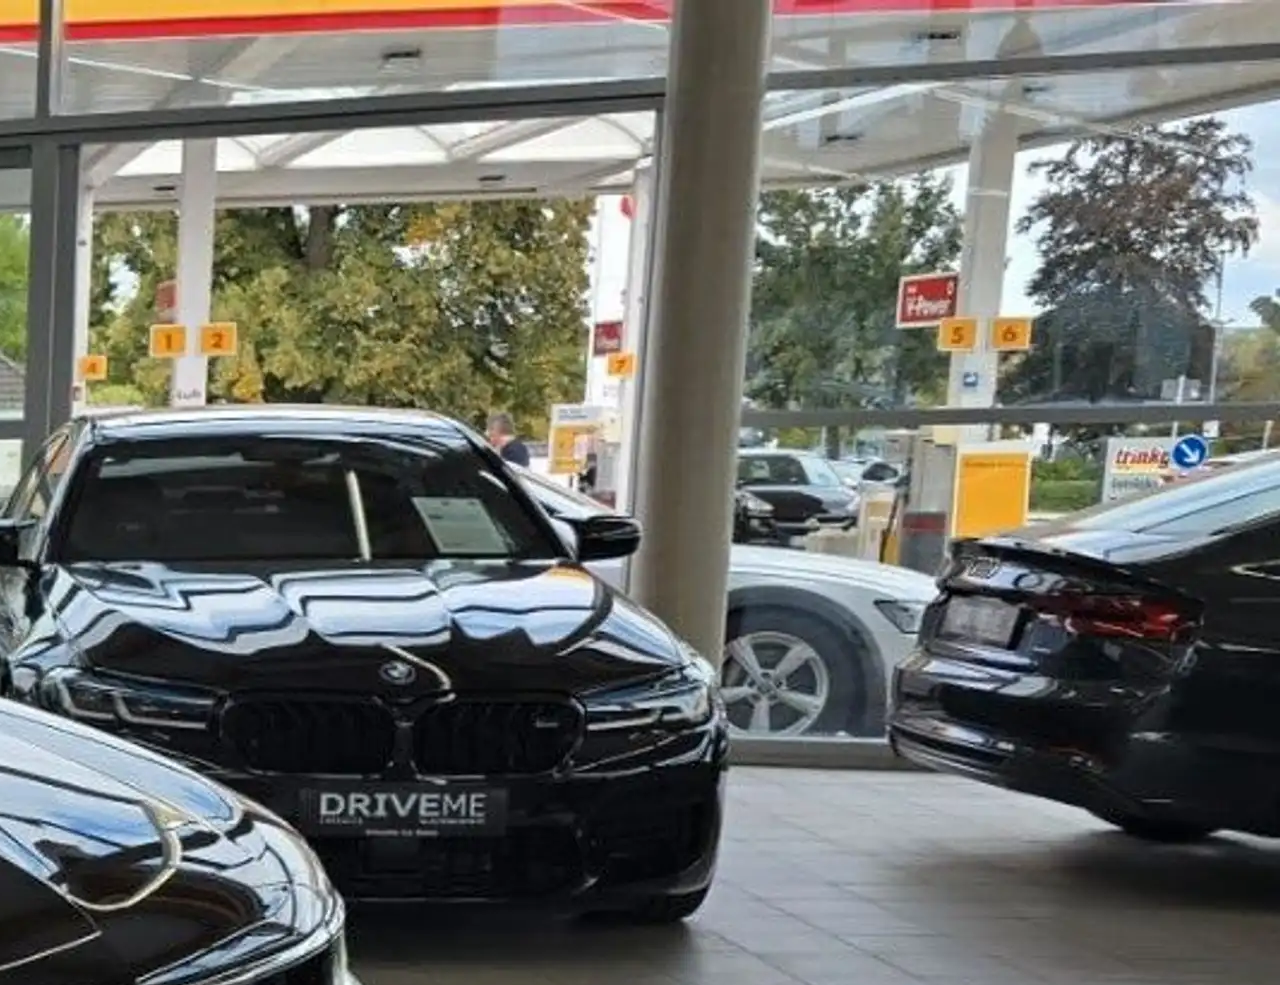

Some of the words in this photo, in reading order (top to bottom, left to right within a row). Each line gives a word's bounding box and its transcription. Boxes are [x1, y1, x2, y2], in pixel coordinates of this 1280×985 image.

[211, 332, 224, 349] 2
[951, 326, 965, 344] 5
[1002, 326, 1017, 342] 6
[319, 792, 487, 818] DRIVEME
